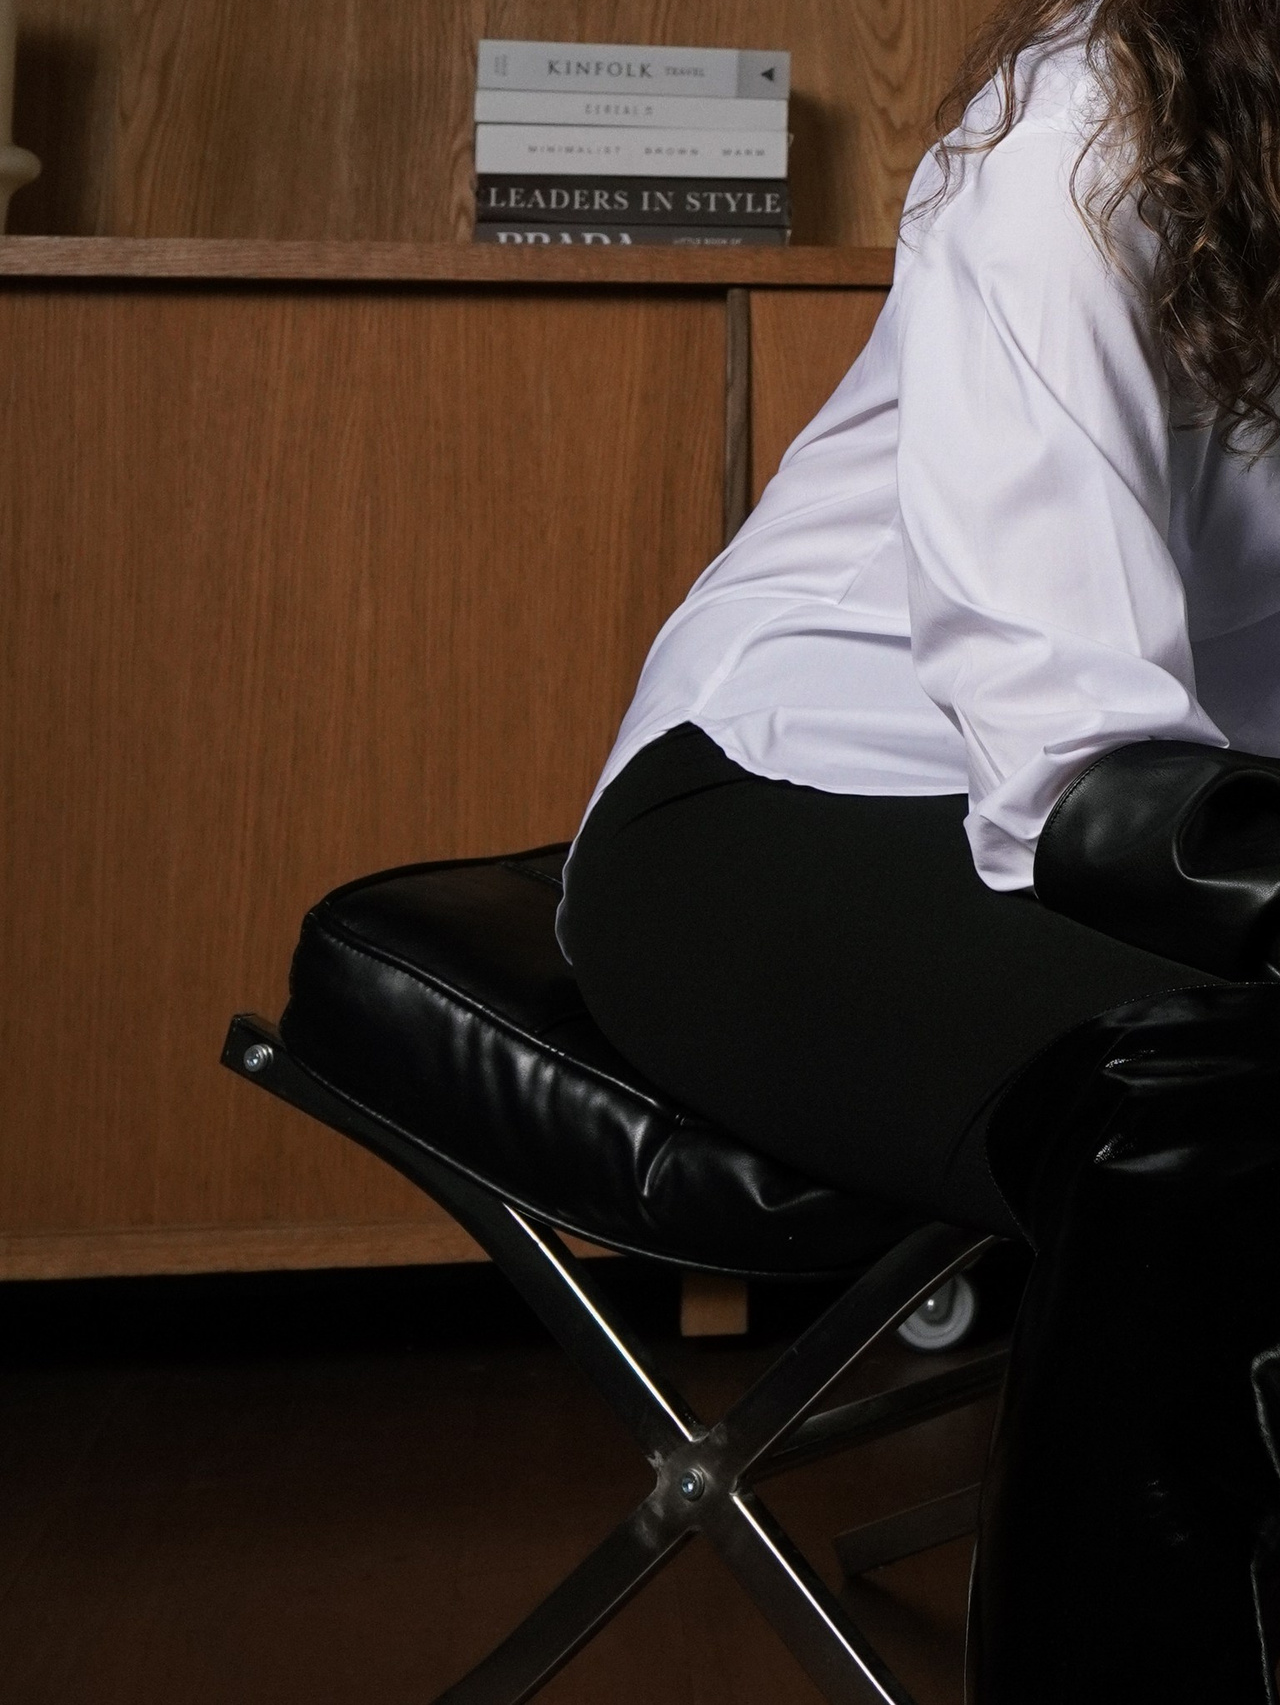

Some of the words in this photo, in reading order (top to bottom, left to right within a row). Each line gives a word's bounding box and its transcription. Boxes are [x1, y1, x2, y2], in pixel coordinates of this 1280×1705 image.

[546, 59, 653, 79] KINFOLK
[489, 186, 630, 211] LEADERS
[641, 190, 675, 212] IN
[684, 191, 782, 214] STYLE
